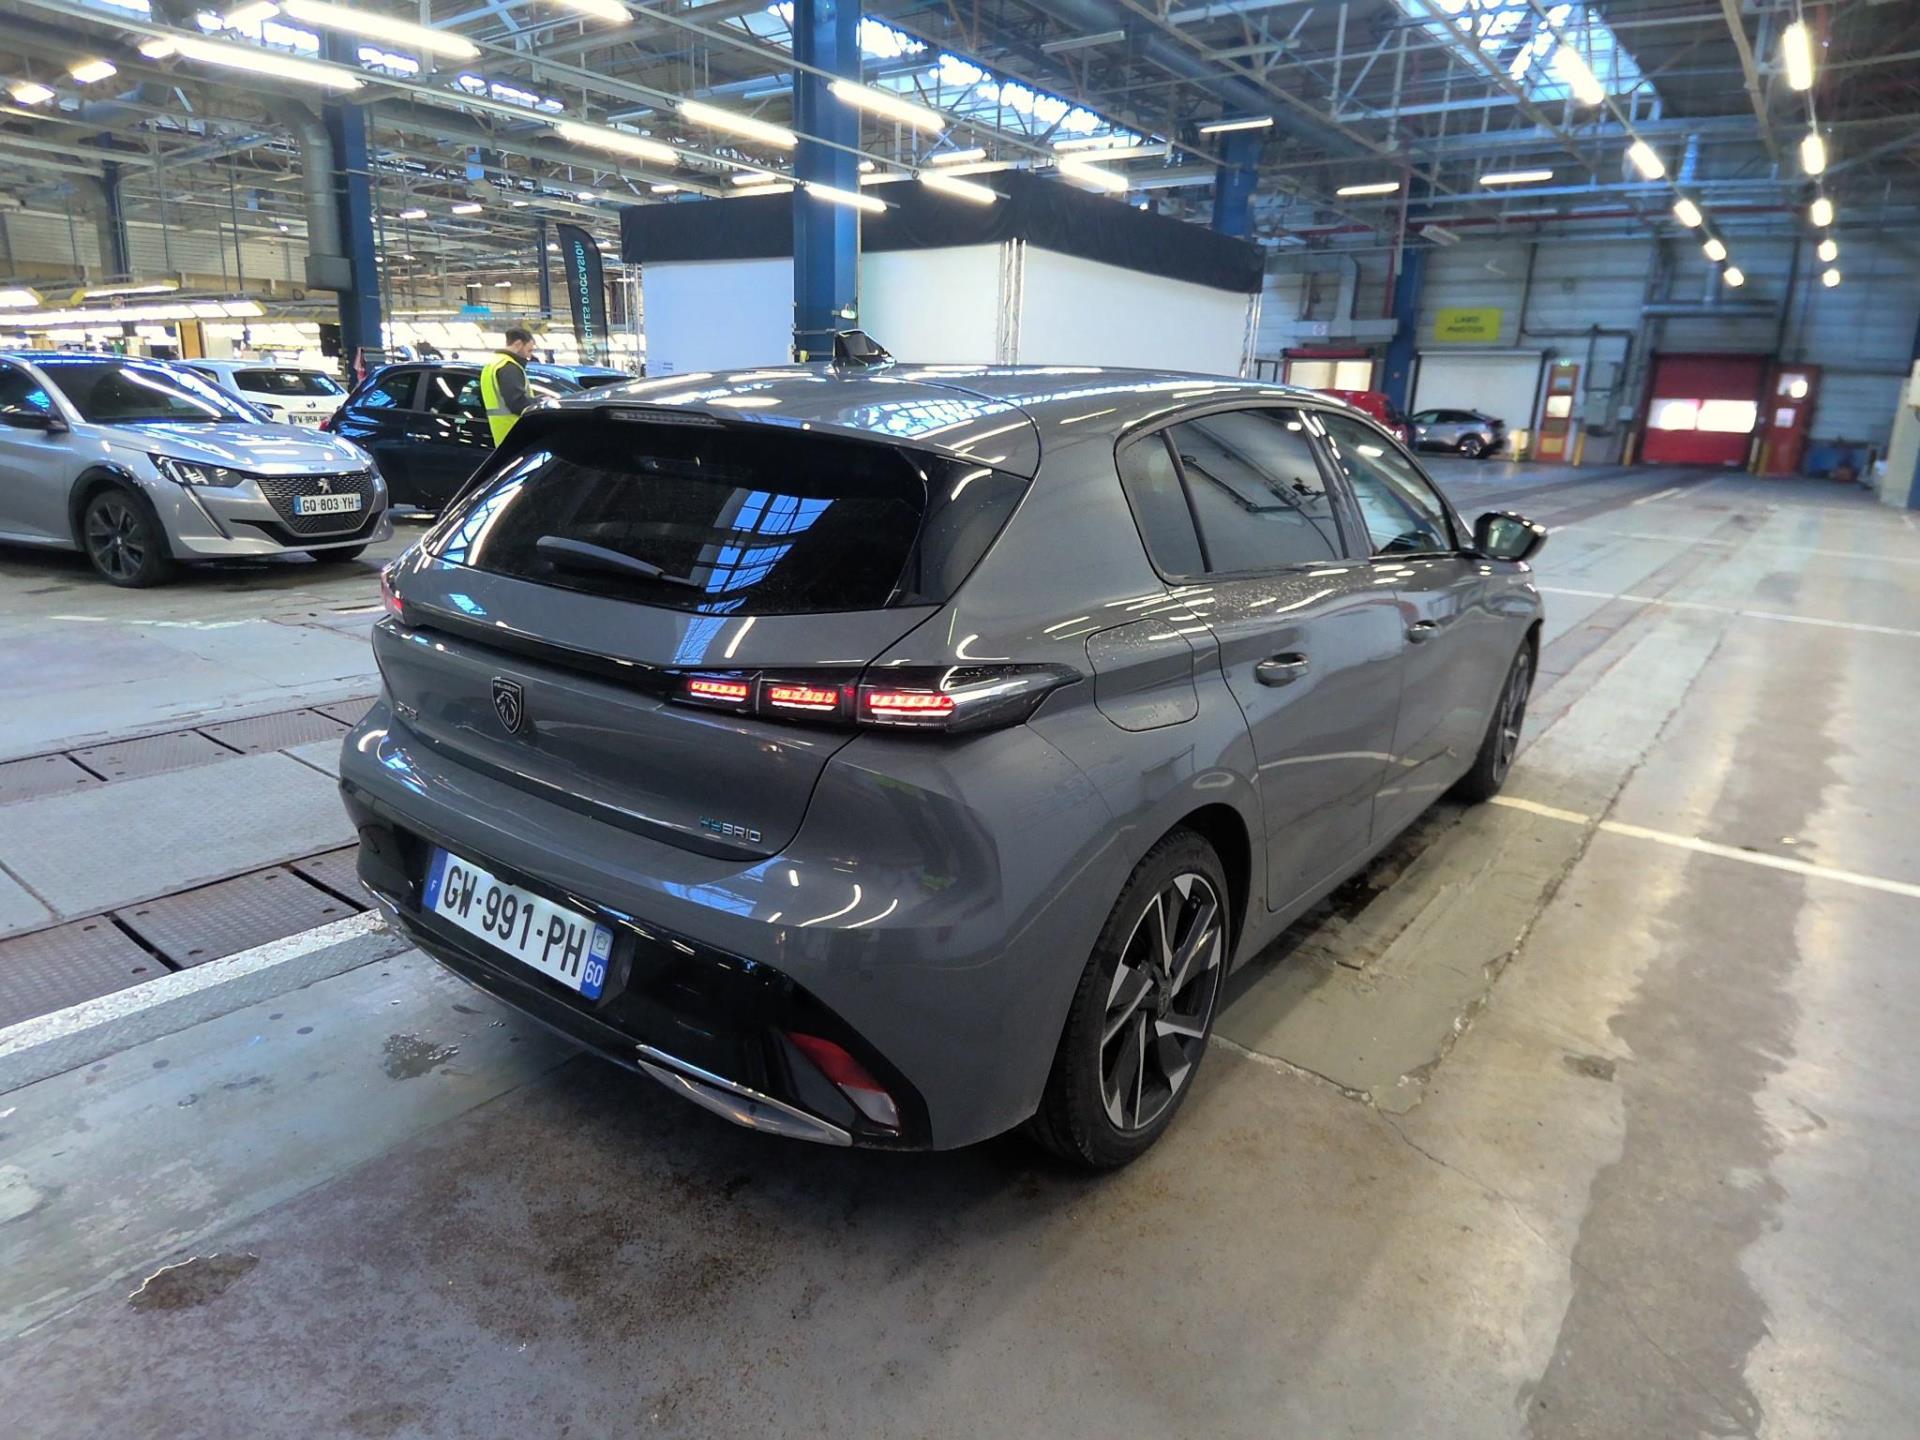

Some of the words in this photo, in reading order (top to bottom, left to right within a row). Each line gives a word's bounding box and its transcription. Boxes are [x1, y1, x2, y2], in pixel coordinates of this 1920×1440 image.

[699, 816, 761, 842] HYBRID
[430, 879, 438, 892] F
[443, 865, 587, 978] GW-991-PH
[584, 960, 603, 988] 60
